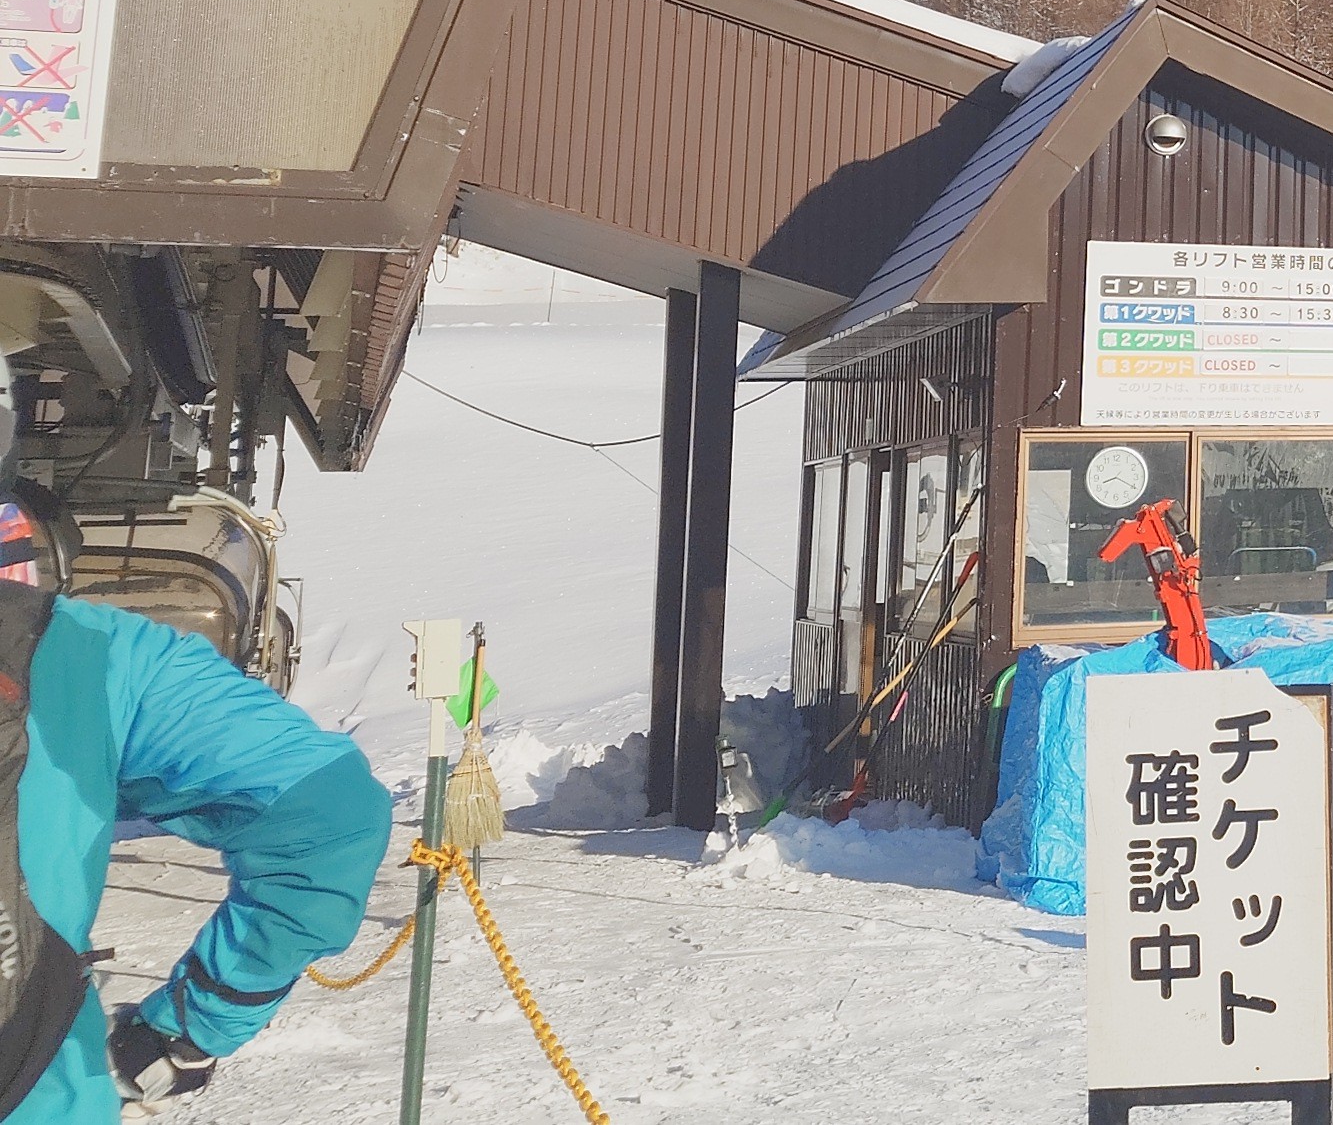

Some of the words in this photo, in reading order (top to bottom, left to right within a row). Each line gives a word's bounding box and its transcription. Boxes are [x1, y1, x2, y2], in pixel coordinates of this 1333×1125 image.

[1104, 278, 1191, 296] ゴンドラ
[1221, 280, 1259, 295] 9:00
[1222, 307, 1259, 320] 8:30
[1207, 333, 1259, 346] CLOSED
[1204, 359, 1257, 372] CLOSED
[1124, 749, 1202, 1001] 確認中
[1209, 709, 1284, 1046] チケット
